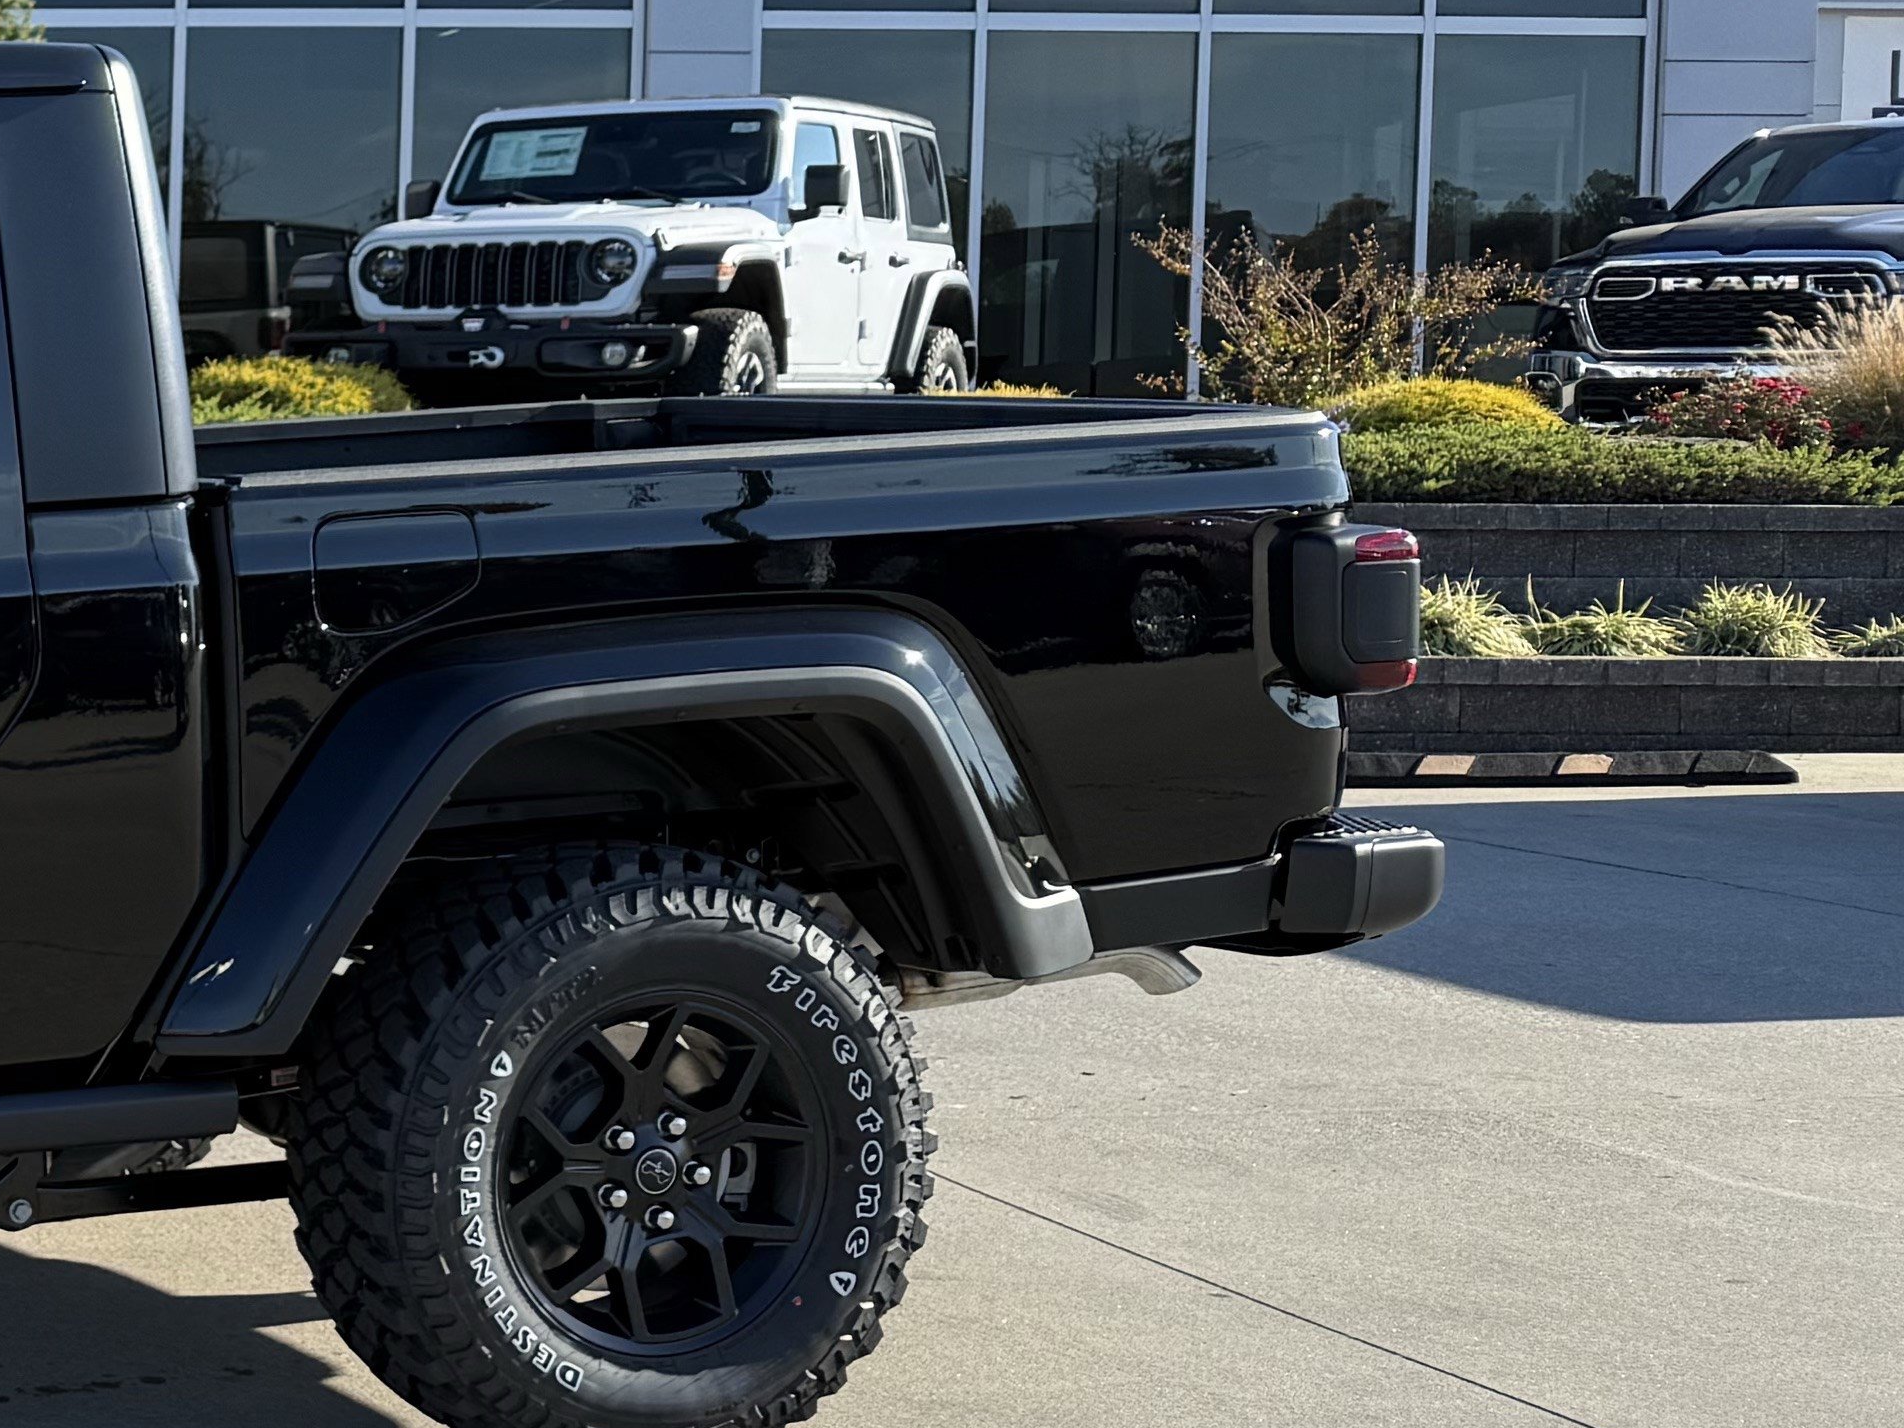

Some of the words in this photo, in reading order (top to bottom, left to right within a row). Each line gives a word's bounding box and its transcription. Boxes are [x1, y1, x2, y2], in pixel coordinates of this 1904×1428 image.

[1657, 275, 1800, 293] RAM
[459, 1091, 584, 1392] DESTINATION
[766, 965, 886, 1261] Firestone
